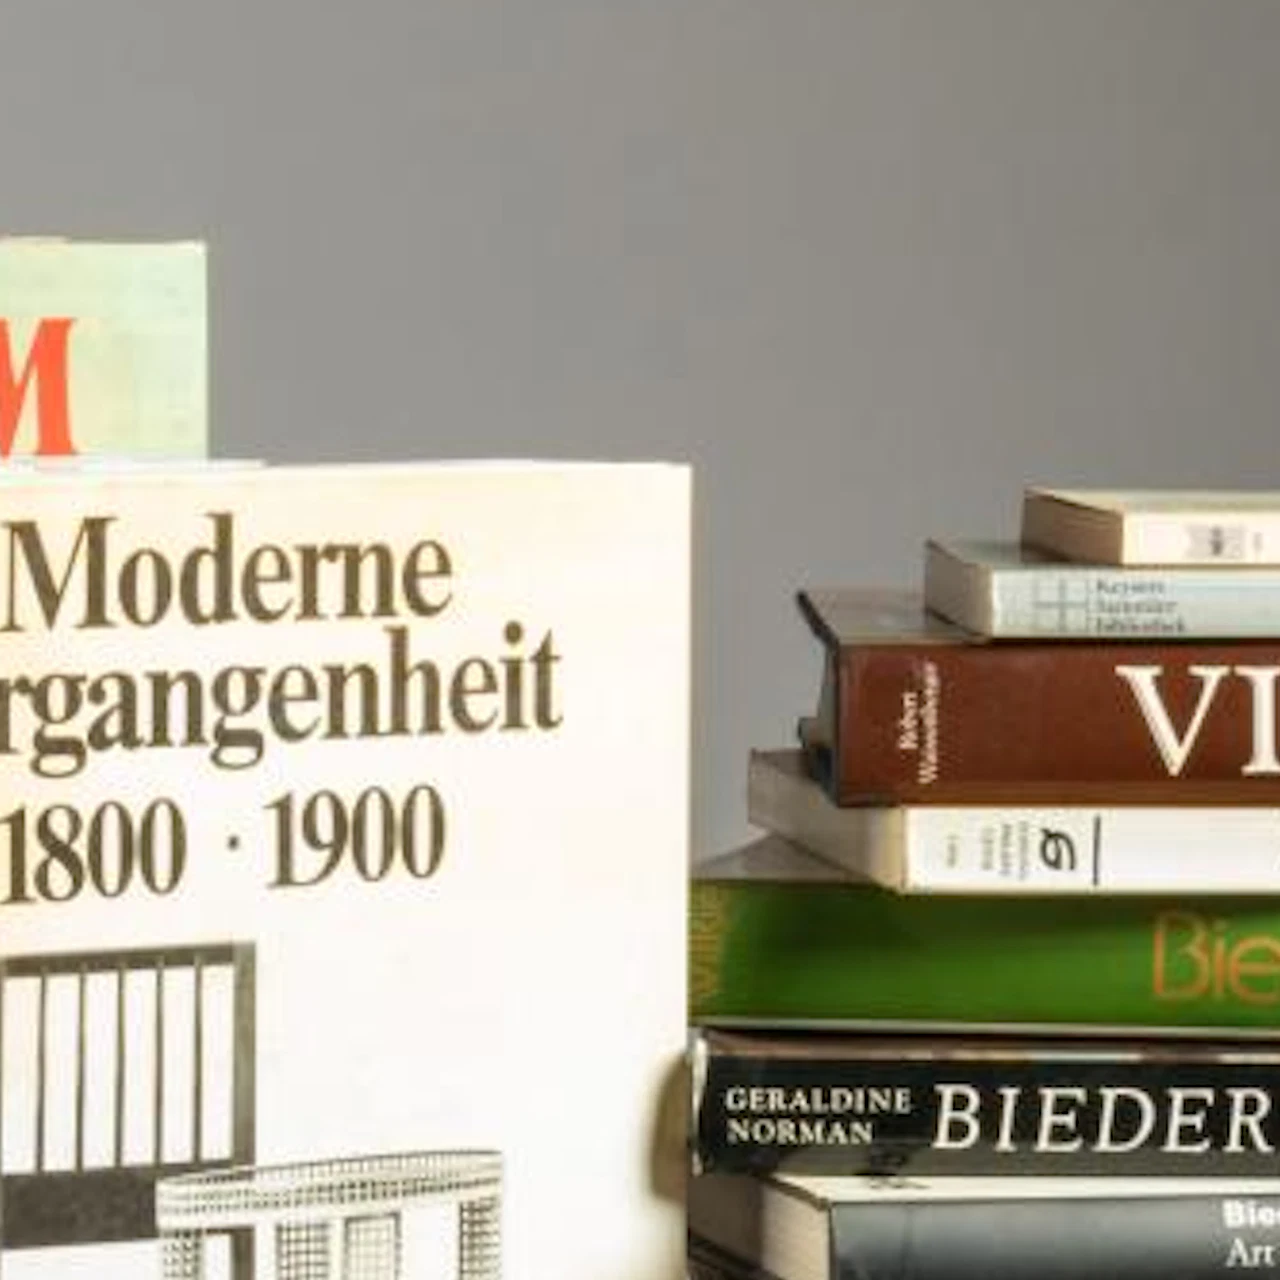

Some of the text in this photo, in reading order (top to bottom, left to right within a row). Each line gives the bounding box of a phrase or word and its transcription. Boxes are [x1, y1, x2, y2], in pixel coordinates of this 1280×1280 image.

[265, 784, 447, 889] 1900
[724, 1086, 911, 1114] GERALDINE
[728, 1118, 873, 1146] NORMAN
[1229, 1236, 1275, 1266] Art
